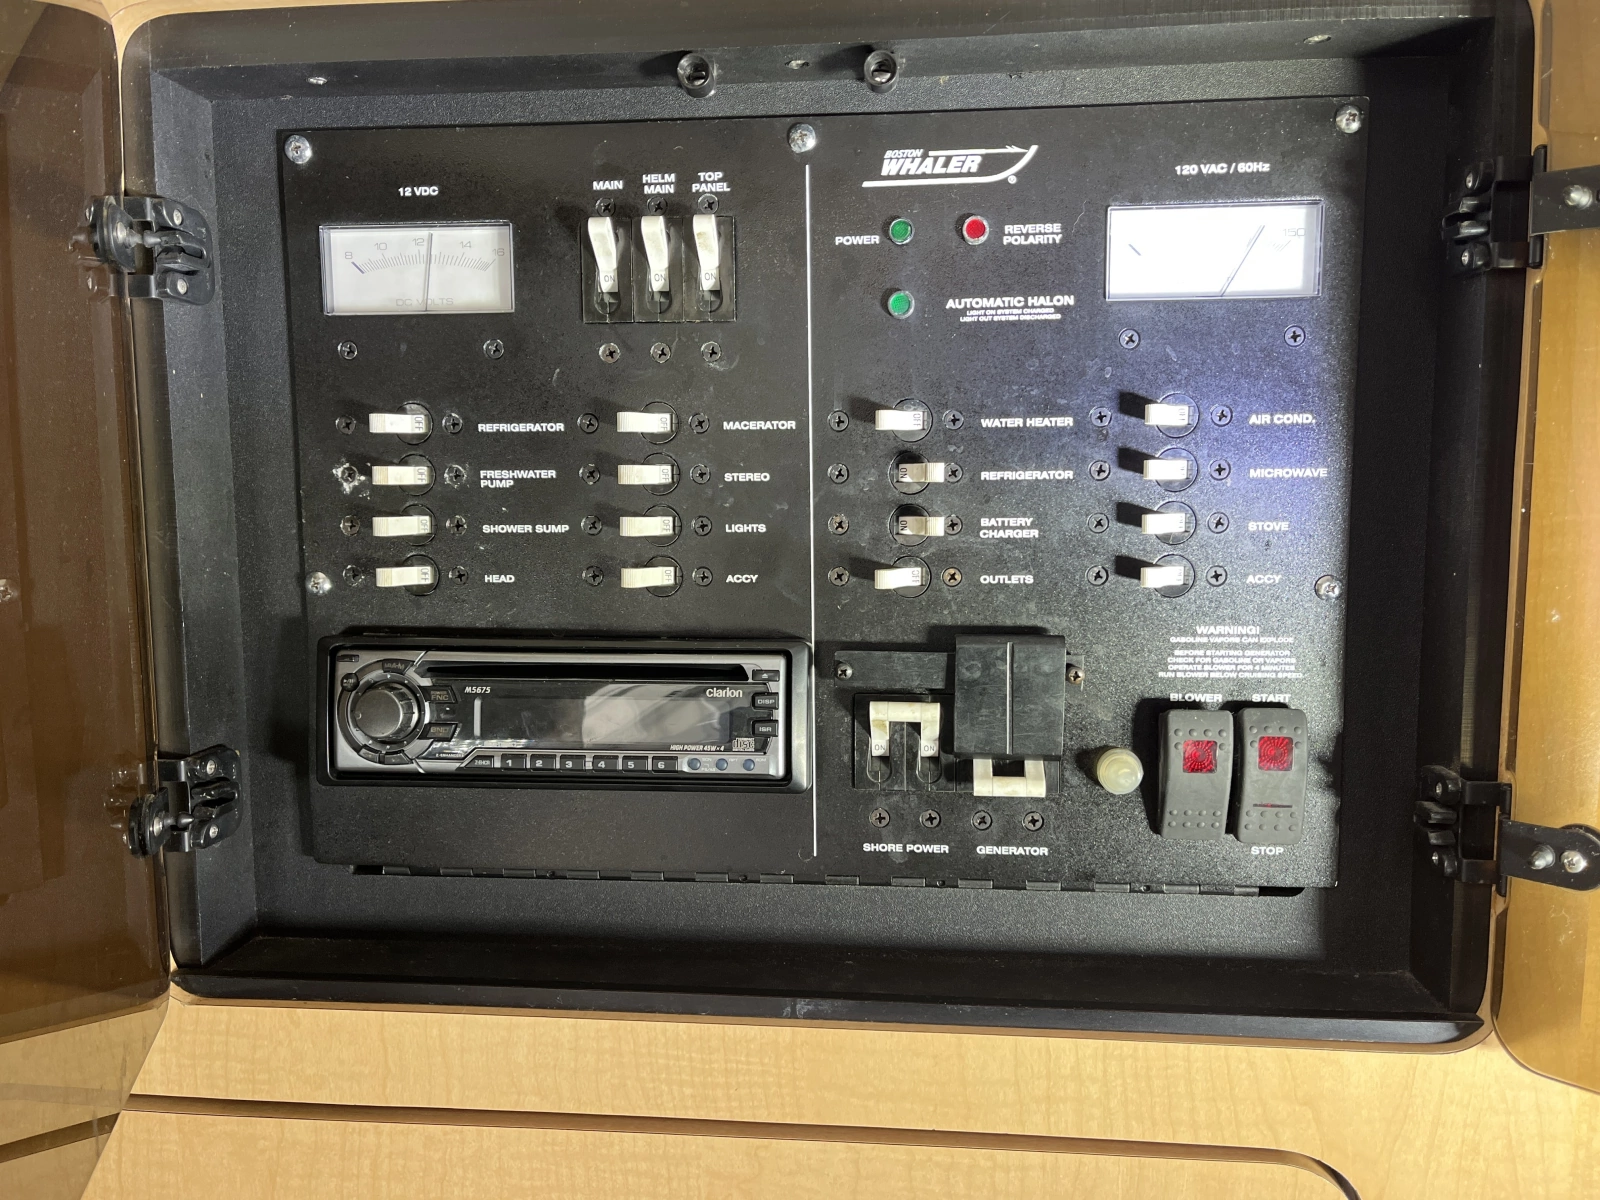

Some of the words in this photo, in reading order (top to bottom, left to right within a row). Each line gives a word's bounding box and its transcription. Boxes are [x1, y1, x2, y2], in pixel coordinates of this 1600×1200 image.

[884, 149, 923, 158] BOSTON
[881, 156, 982, 175] WHALER
[1175, 165, 1198, 175] 120
[1200, 164, 1227, 174] VAC
[1230, 163, 1235, 173] /
[1238, 162, 1270, 172] 60Hz
[642, 173, 675, 183] HELM
[698, 171, 722, 182] TOP
[593, 180, 623, 190] MAIN
[644, 184, 674, 194] MAIN
[692, 182, 730, 193] PANEL
[398, 187, 413, 196] 12
[414, 186, 439, 196] VDC
[1004, 224, 1061, 234] REVERSE
[412, 238, 425, 246] 12
[460, 241, 471, 249] 14
[835, 235, 880, 245] POWER
[1003, 235, 1062, 245] POLARITY
[492, 249, 505, 257] 16
[603, 274, 615, 284] ON
[654, 273, 666, 283] ON
[704, 272, 716, 281] ON
[396, 299, 412, 307] DC
[416, 298, 453, 306] VOLTS
[945, 297, 1024, 309] AUTOMATIC
[1027, 295, 1074, 307] HALON
[913, 413, 921, 427] OFF
[981, 418, 1024, 428] WATER
[1026, 417, 1074, 427] HEATER
[1248, 414, 1271, 425] AIR
[1273, 413, 1316, 424] COND.
[478, 423, 564, 432] REFRIGERATOR
[723, 420, 796, 430] MACERATOR
[480, 470, 556, 479] FRESHWATER
[724, 472, 770, 482] STEREO
[900, 467, 907, 479] ON
[980, 470, 1074, 480] REFRIGERATOR
[1249, 468, 1328, 478] MICROWAVE
[480, 480, 514, 488] PUMP
[900, 520, 908, 531] ON
[980, 517, 1033, 527] BATTERY
[1248, 521, 1289, 531] STOVE
[482, 525, 533, 533] SHOWER
[535, 524, 570, 533] SUMP
[725, 524, 767, 533] LIGHTS
[979, 529, 1039, 539] CHARGER
[484, 575, 515, 583] HEAD
[726, 574, 758, 583] ACCY
[980, 575, 1034, 584] OUTLETS
[1246, 574, 1281, 584] ACCY
[1196, 625, 1260, 635] WARNING!
[464, 686, 491, 694] M5675
[1169, 693, 1222, 703] BLOWER
[1252, 693, 1291, 703] START
[506, 759, 512, 767] 1
[535, 759, 543, 767] 2
[565, 760, 573, 768] 3
[862, 843, 903, 852] SHORE
[906, 844, 949, 853] POWER
[976, 845, 1049, 856] GENERATOR
[1251, 846, 1284, 855] STOP
